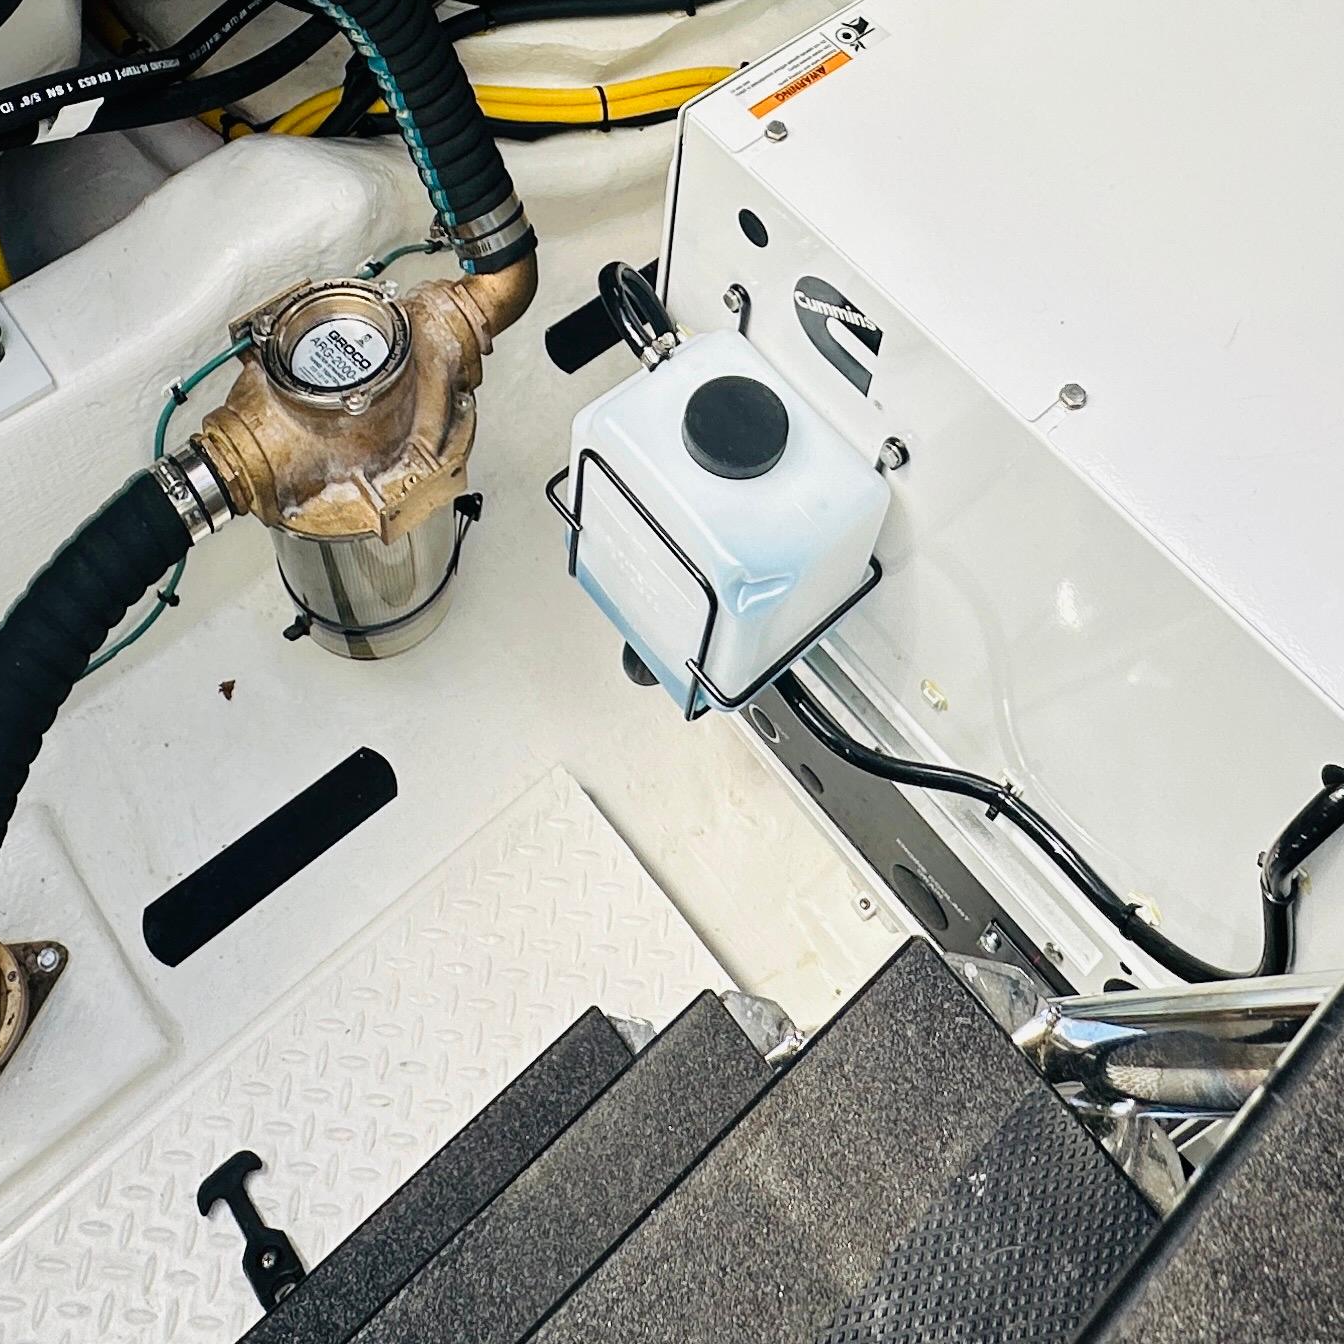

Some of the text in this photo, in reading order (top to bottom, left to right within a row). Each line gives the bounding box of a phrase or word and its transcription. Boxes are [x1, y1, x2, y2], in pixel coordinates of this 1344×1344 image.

[775, 68, 820, 102] WARNING
[794, 291, 882, 332] Cummins
[310, 337, 357, 380] ARG-2000-
[329, 330, 372, 370] GROCO
